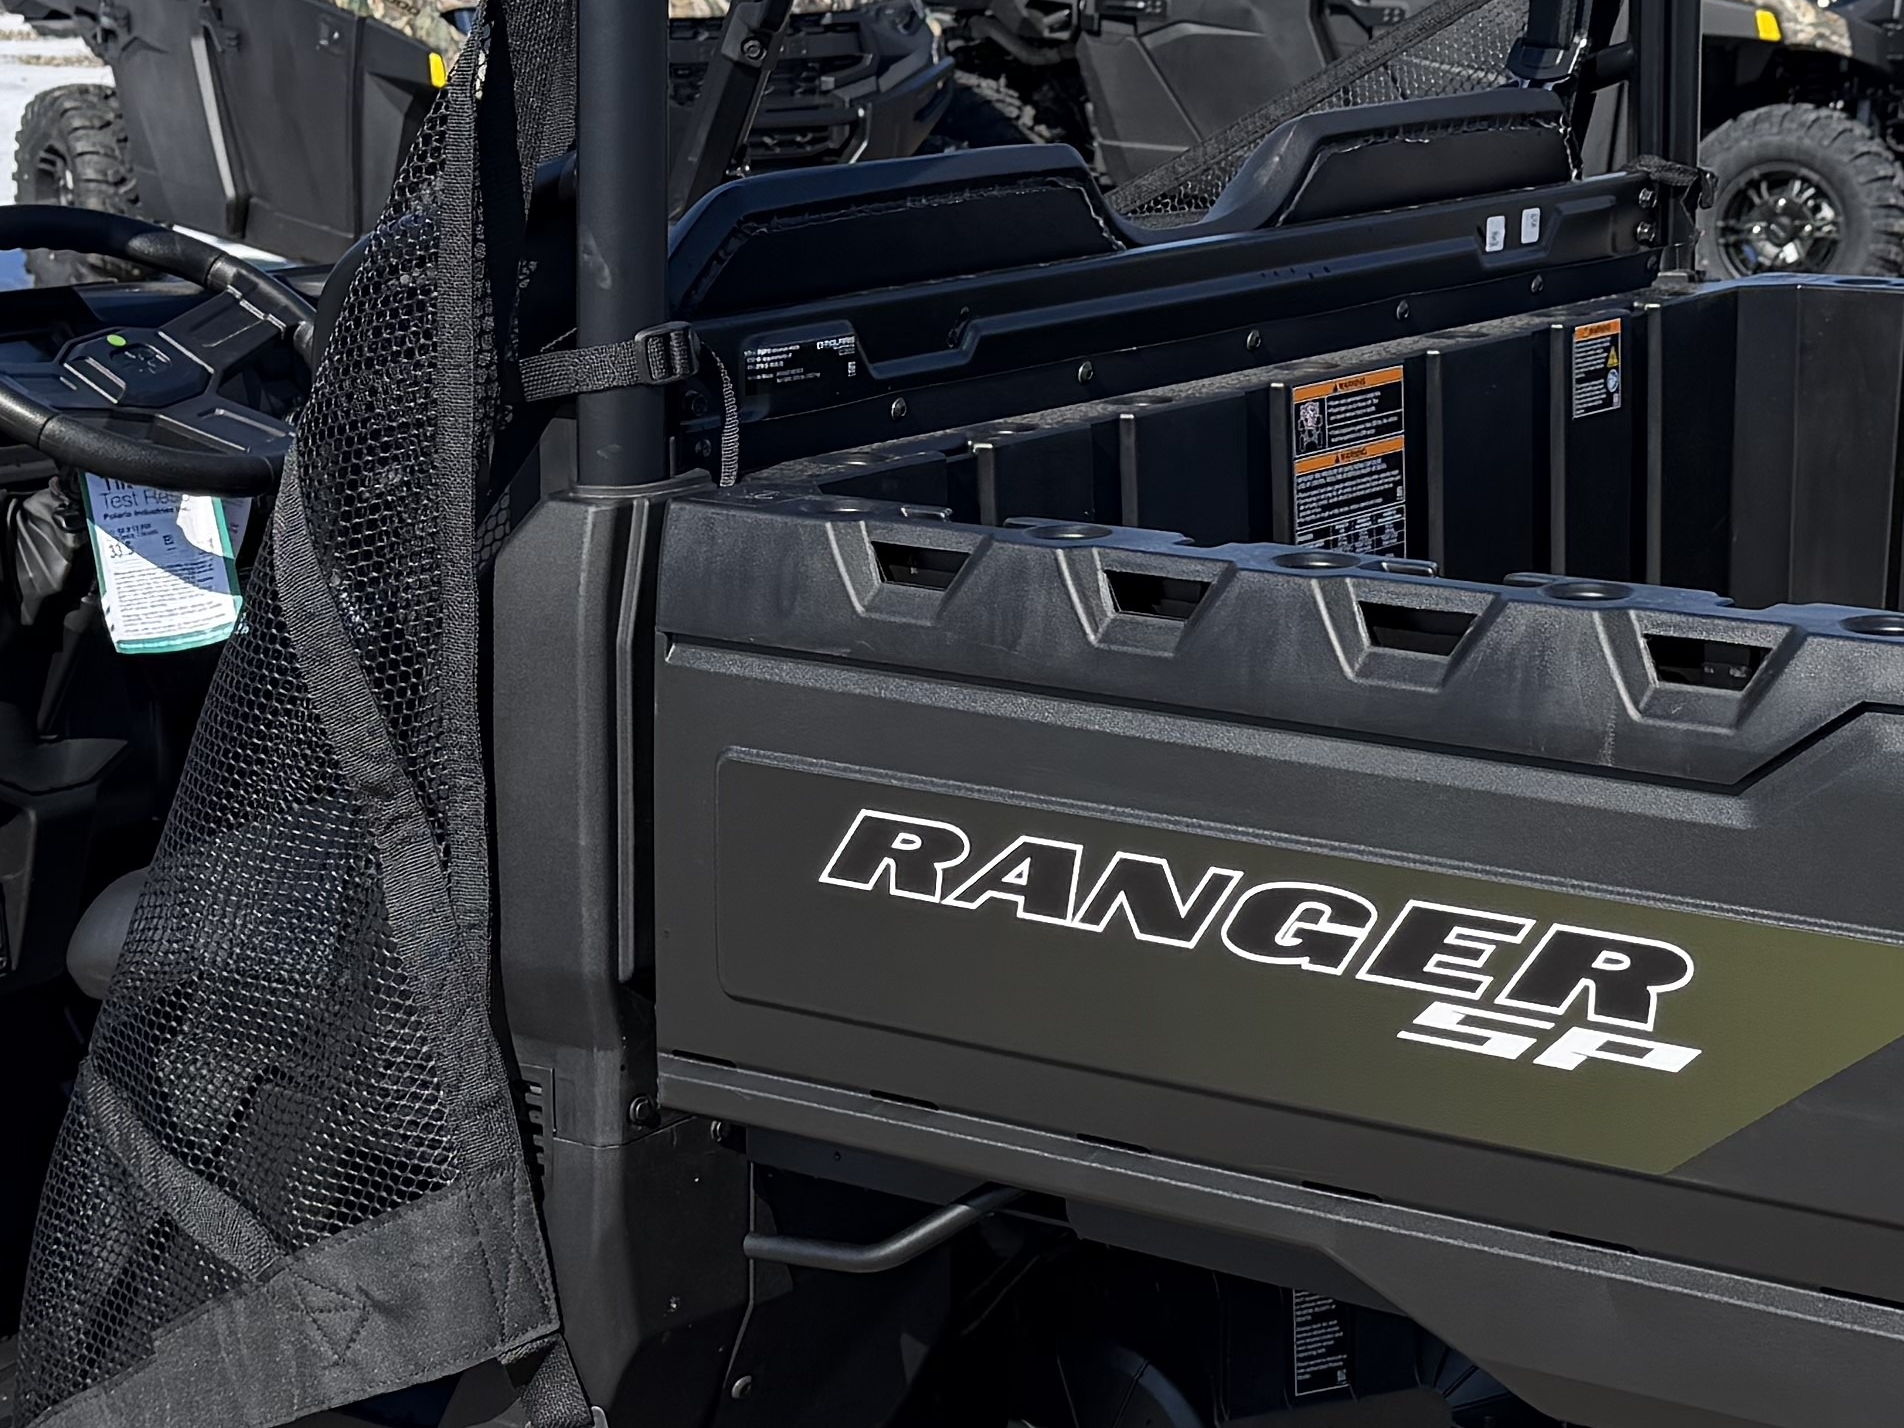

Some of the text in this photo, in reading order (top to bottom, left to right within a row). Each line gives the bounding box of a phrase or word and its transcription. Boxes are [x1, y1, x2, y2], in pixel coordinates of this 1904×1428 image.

[99, 491, 138, 510] Test
[818, 808, 1695, 1031] RANGER
[1397, 1001, 1702, 1073] SP
